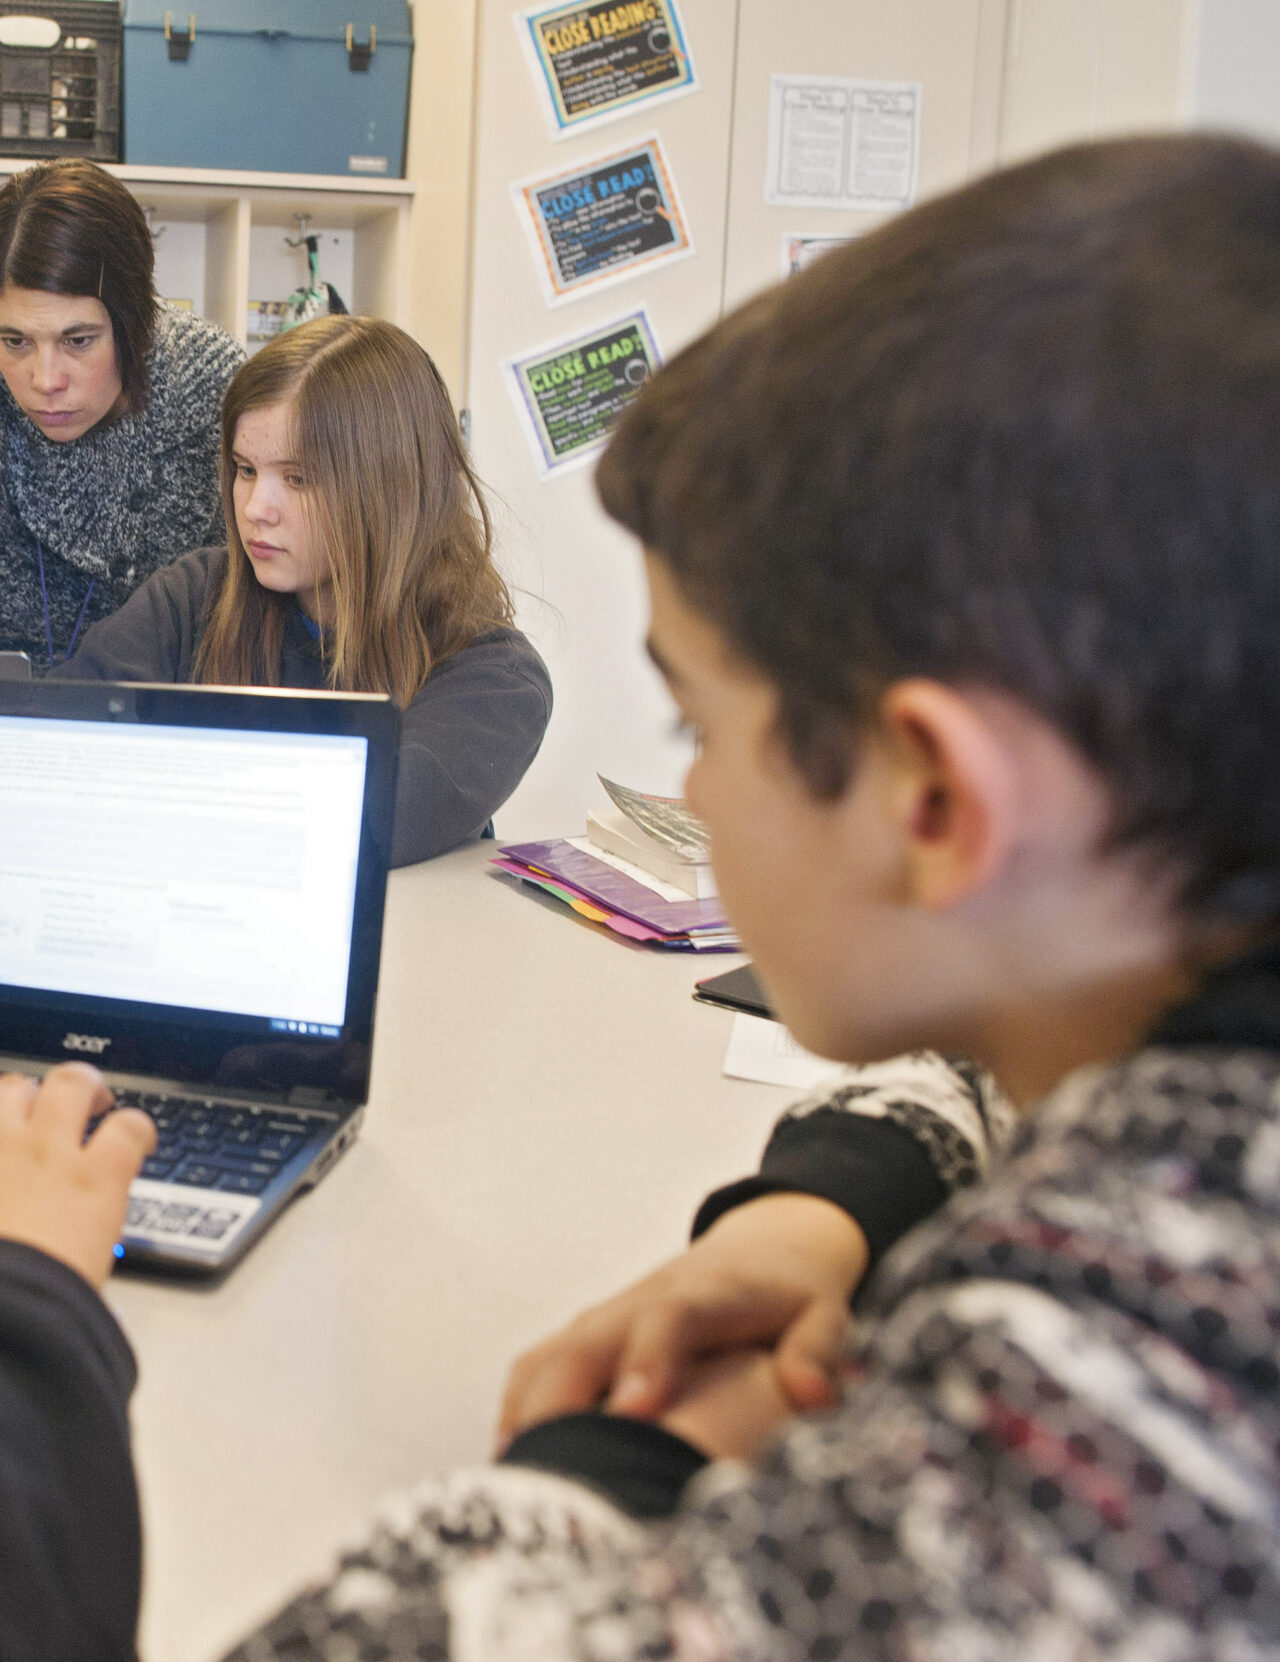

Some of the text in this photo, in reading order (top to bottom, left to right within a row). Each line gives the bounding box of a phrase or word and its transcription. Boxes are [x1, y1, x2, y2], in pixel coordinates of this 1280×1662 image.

[544, 20, 592, 55] CLOSE
[542, 187, 595, 218] CLOSE
[530, 357, 587, 393] CLOSE
[587, 334, 643, 370] READ?
[62, 1033, 111, 1054] acer
